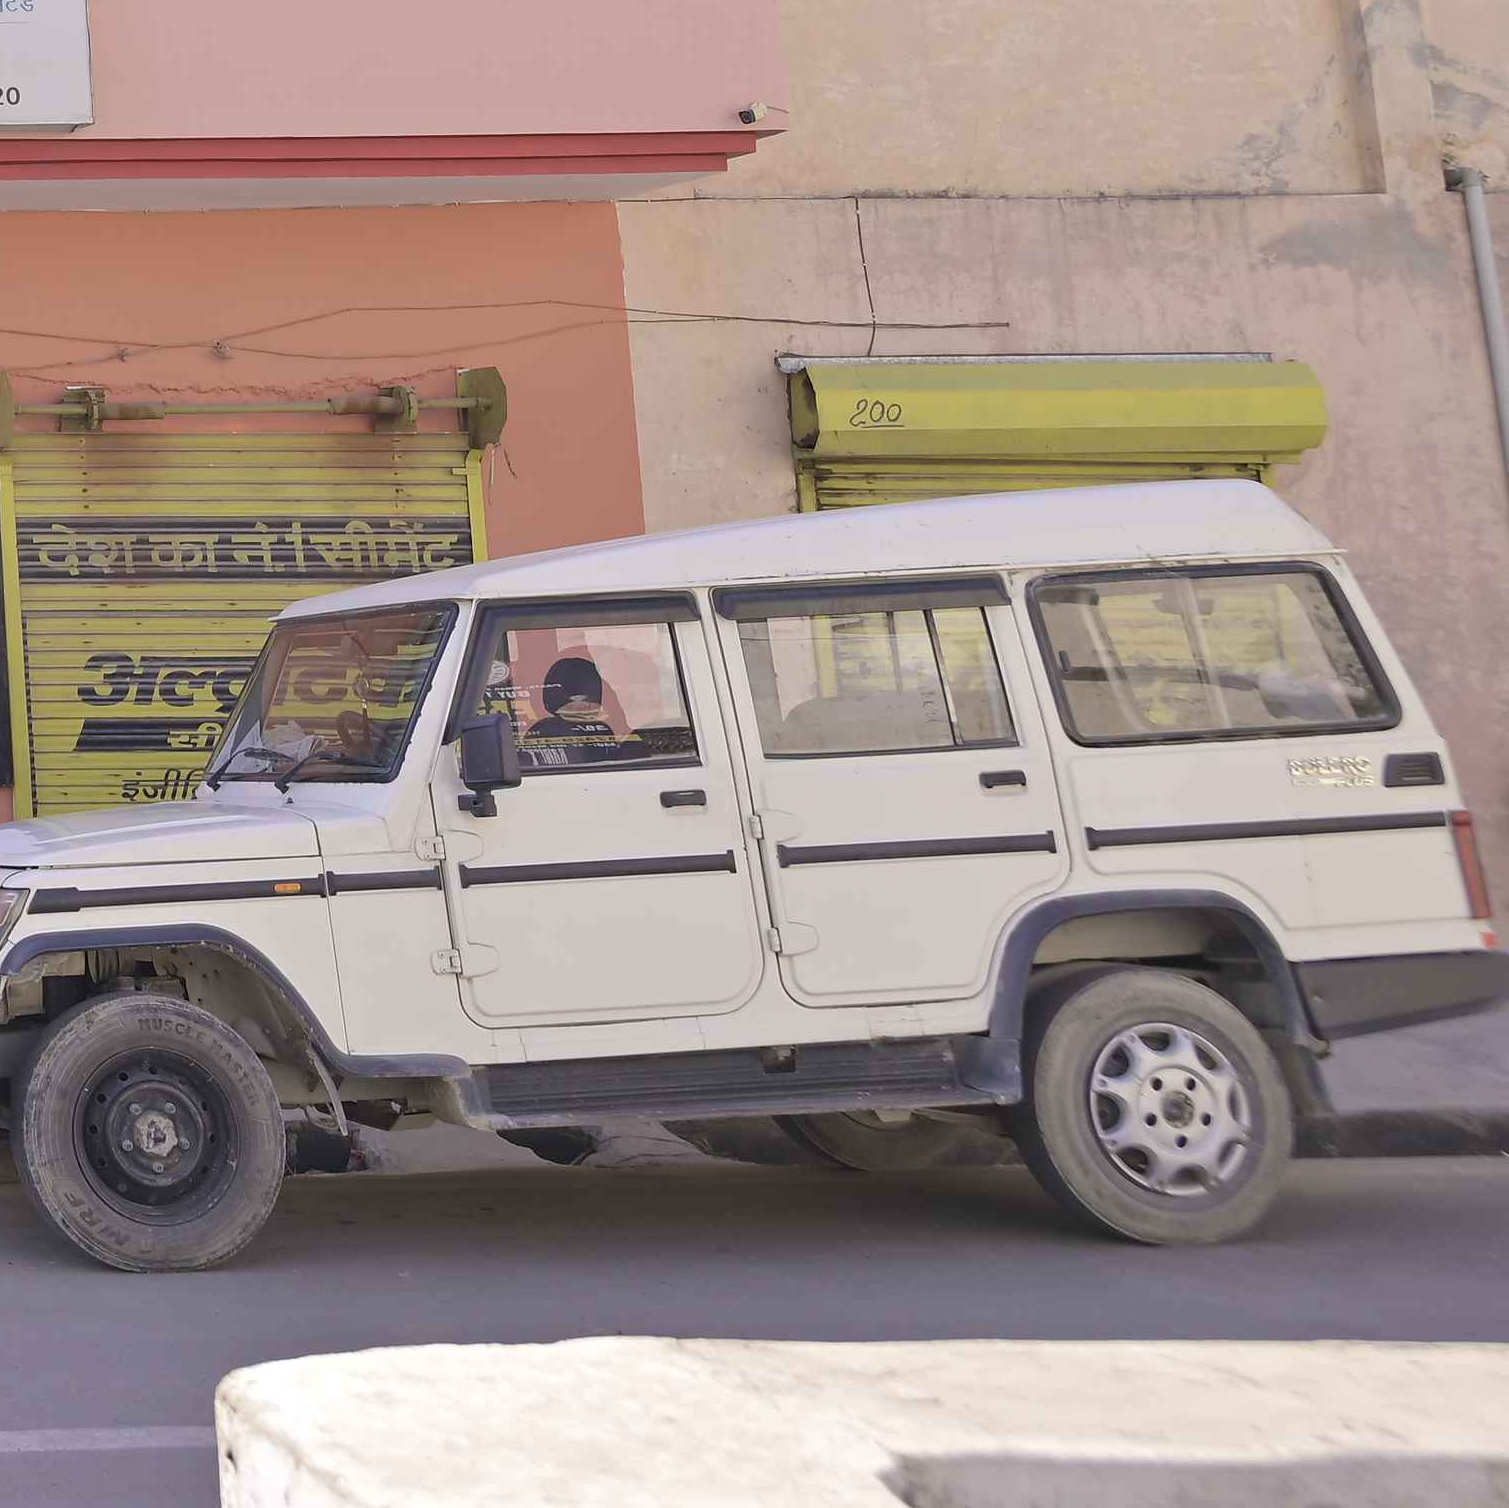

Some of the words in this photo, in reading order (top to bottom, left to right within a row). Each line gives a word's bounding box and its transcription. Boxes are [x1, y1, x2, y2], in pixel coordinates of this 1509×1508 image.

[848, 398, 904, 428] 200
[31, 522, 139, 577] देश
[138, 531, 219, 574] का
[137, 1017, 207, 1043] MUSCLE
[63, 1192, 131, 1248] MRF
